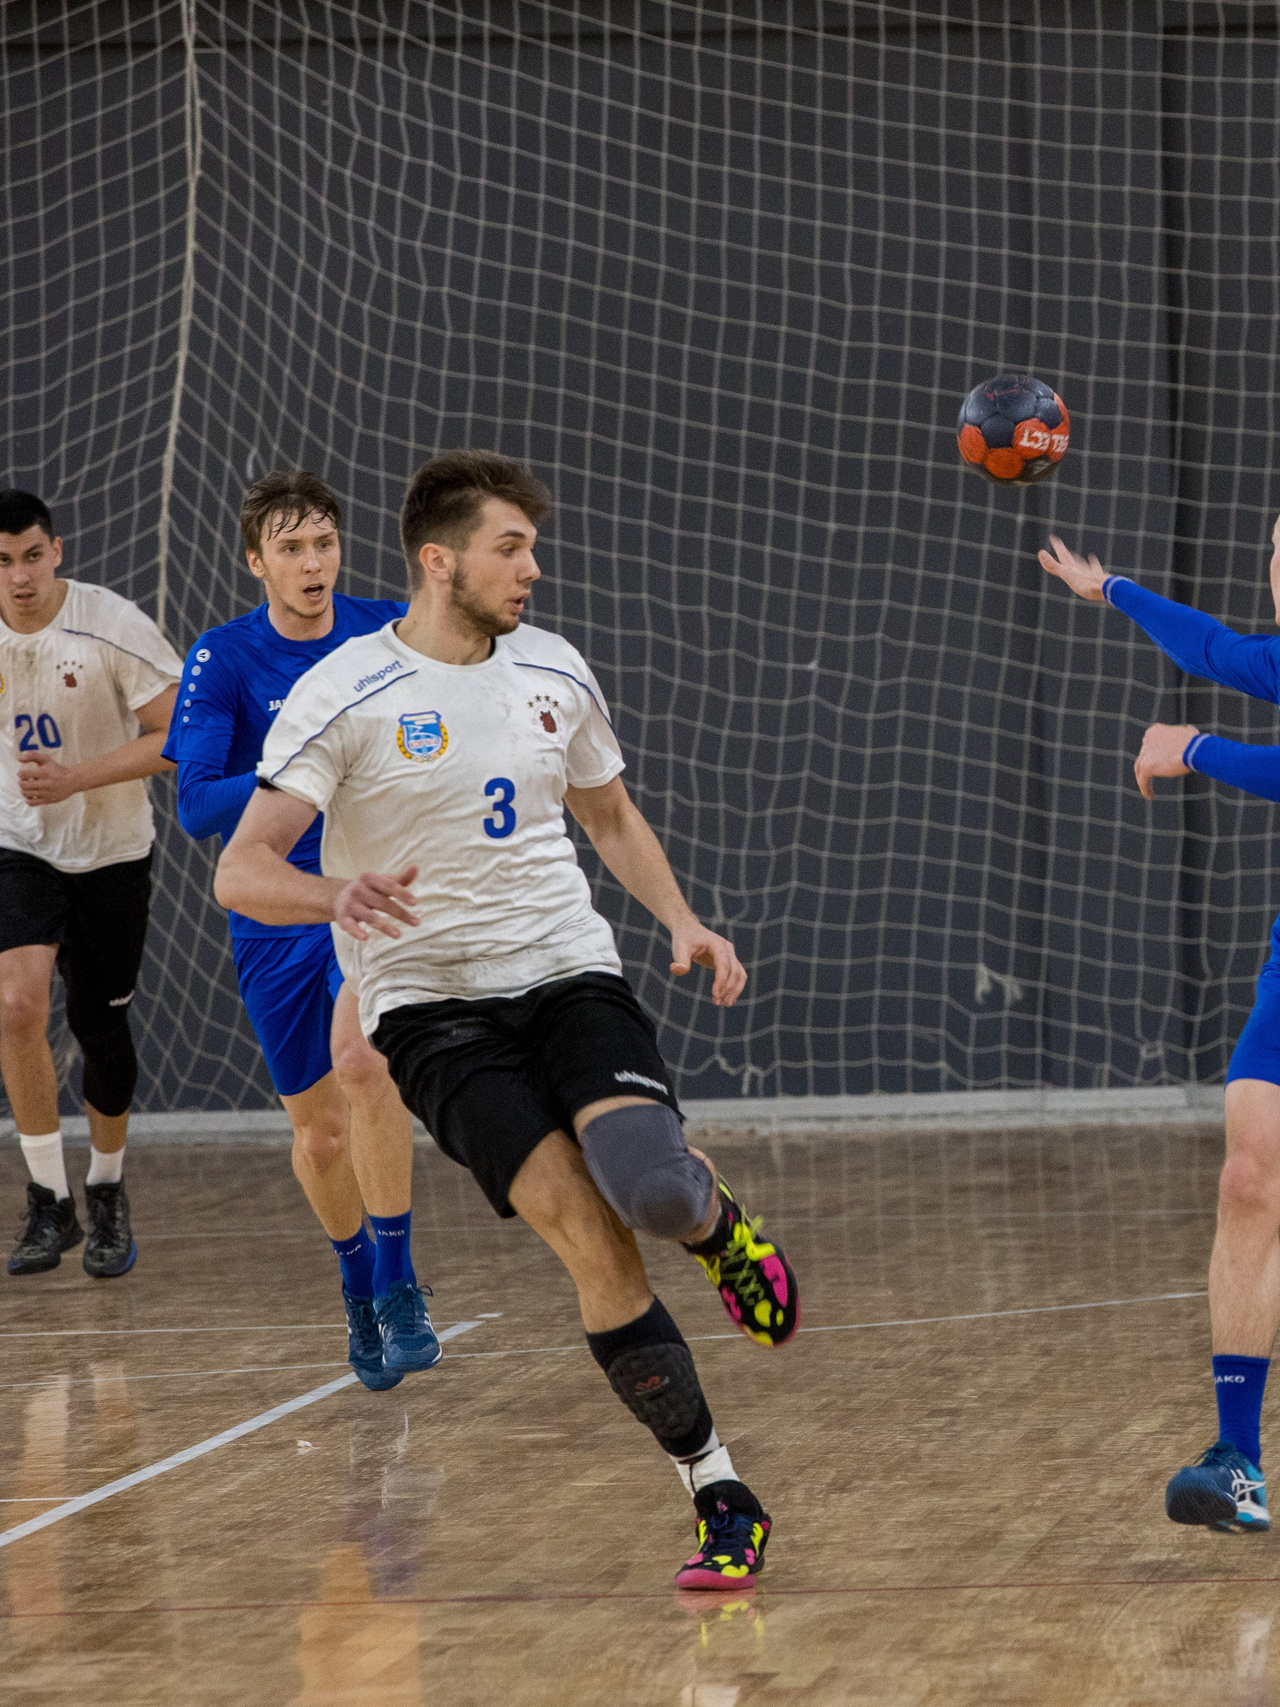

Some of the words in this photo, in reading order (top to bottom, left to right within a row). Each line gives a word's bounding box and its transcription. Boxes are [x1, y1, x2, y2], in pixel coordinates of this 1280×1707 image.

[353, 660, 404, 693] uhlsport
[15, 713, 62, 752] 20
[483, 777, 516, 839] 3
